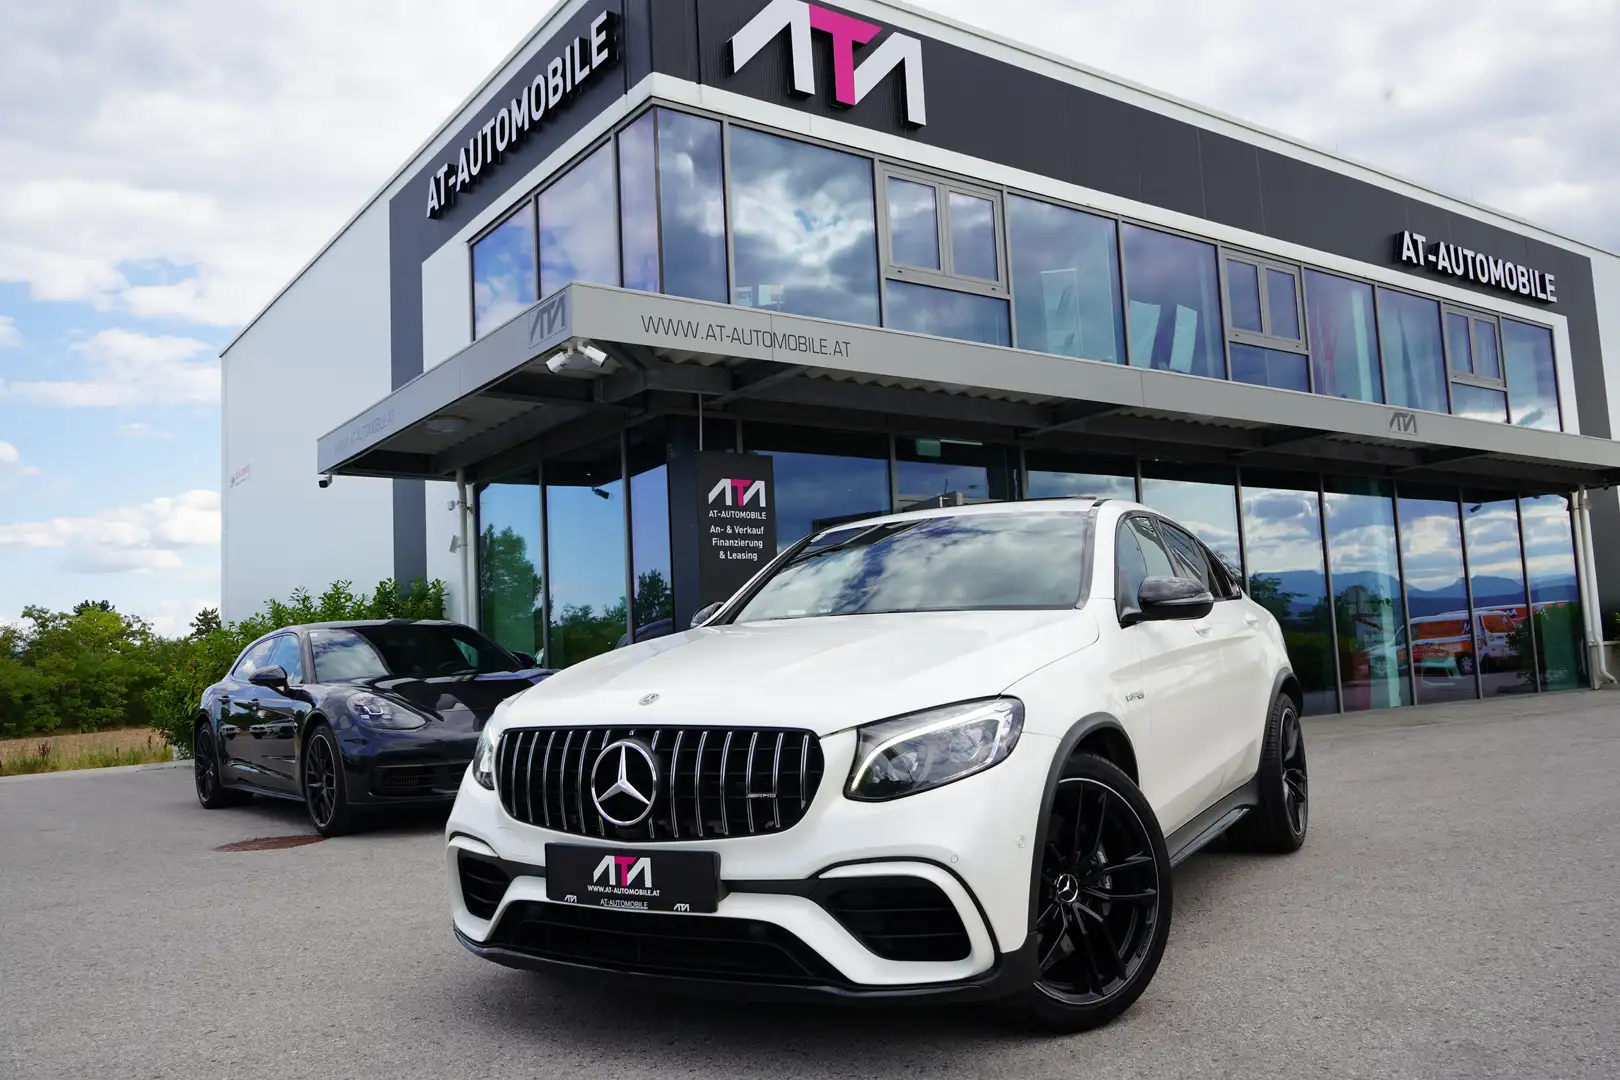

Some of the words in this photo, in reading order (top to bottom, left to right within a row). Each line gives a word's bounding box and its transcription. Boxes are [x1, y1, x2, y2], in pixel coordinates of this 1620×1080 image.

[426, 10, 609, 219] AT-AUTOMOBILE
[1401, 230, 1558, 303] AT-AUTOMOBILE
[640, 314, 851, 358] WWW.AT-AUTOMOBILE.AT
[708, 509, 767, 520] AT-AUTOMOBILE
[709, 524, 725, 534] An-
[726, 525, 733, 534] &
[733, 525, 765, 535] Verkauf
[711, 537, 763, 549] Finanzierung
[719, 550, 726, 559] &
[727, 550, 758, 561] Leasing
[587, 884, 660, 897] WWW.AT-AUTOMOBILE.AT
[600, 898, 649, 910] AT-AUTOMOBILE
